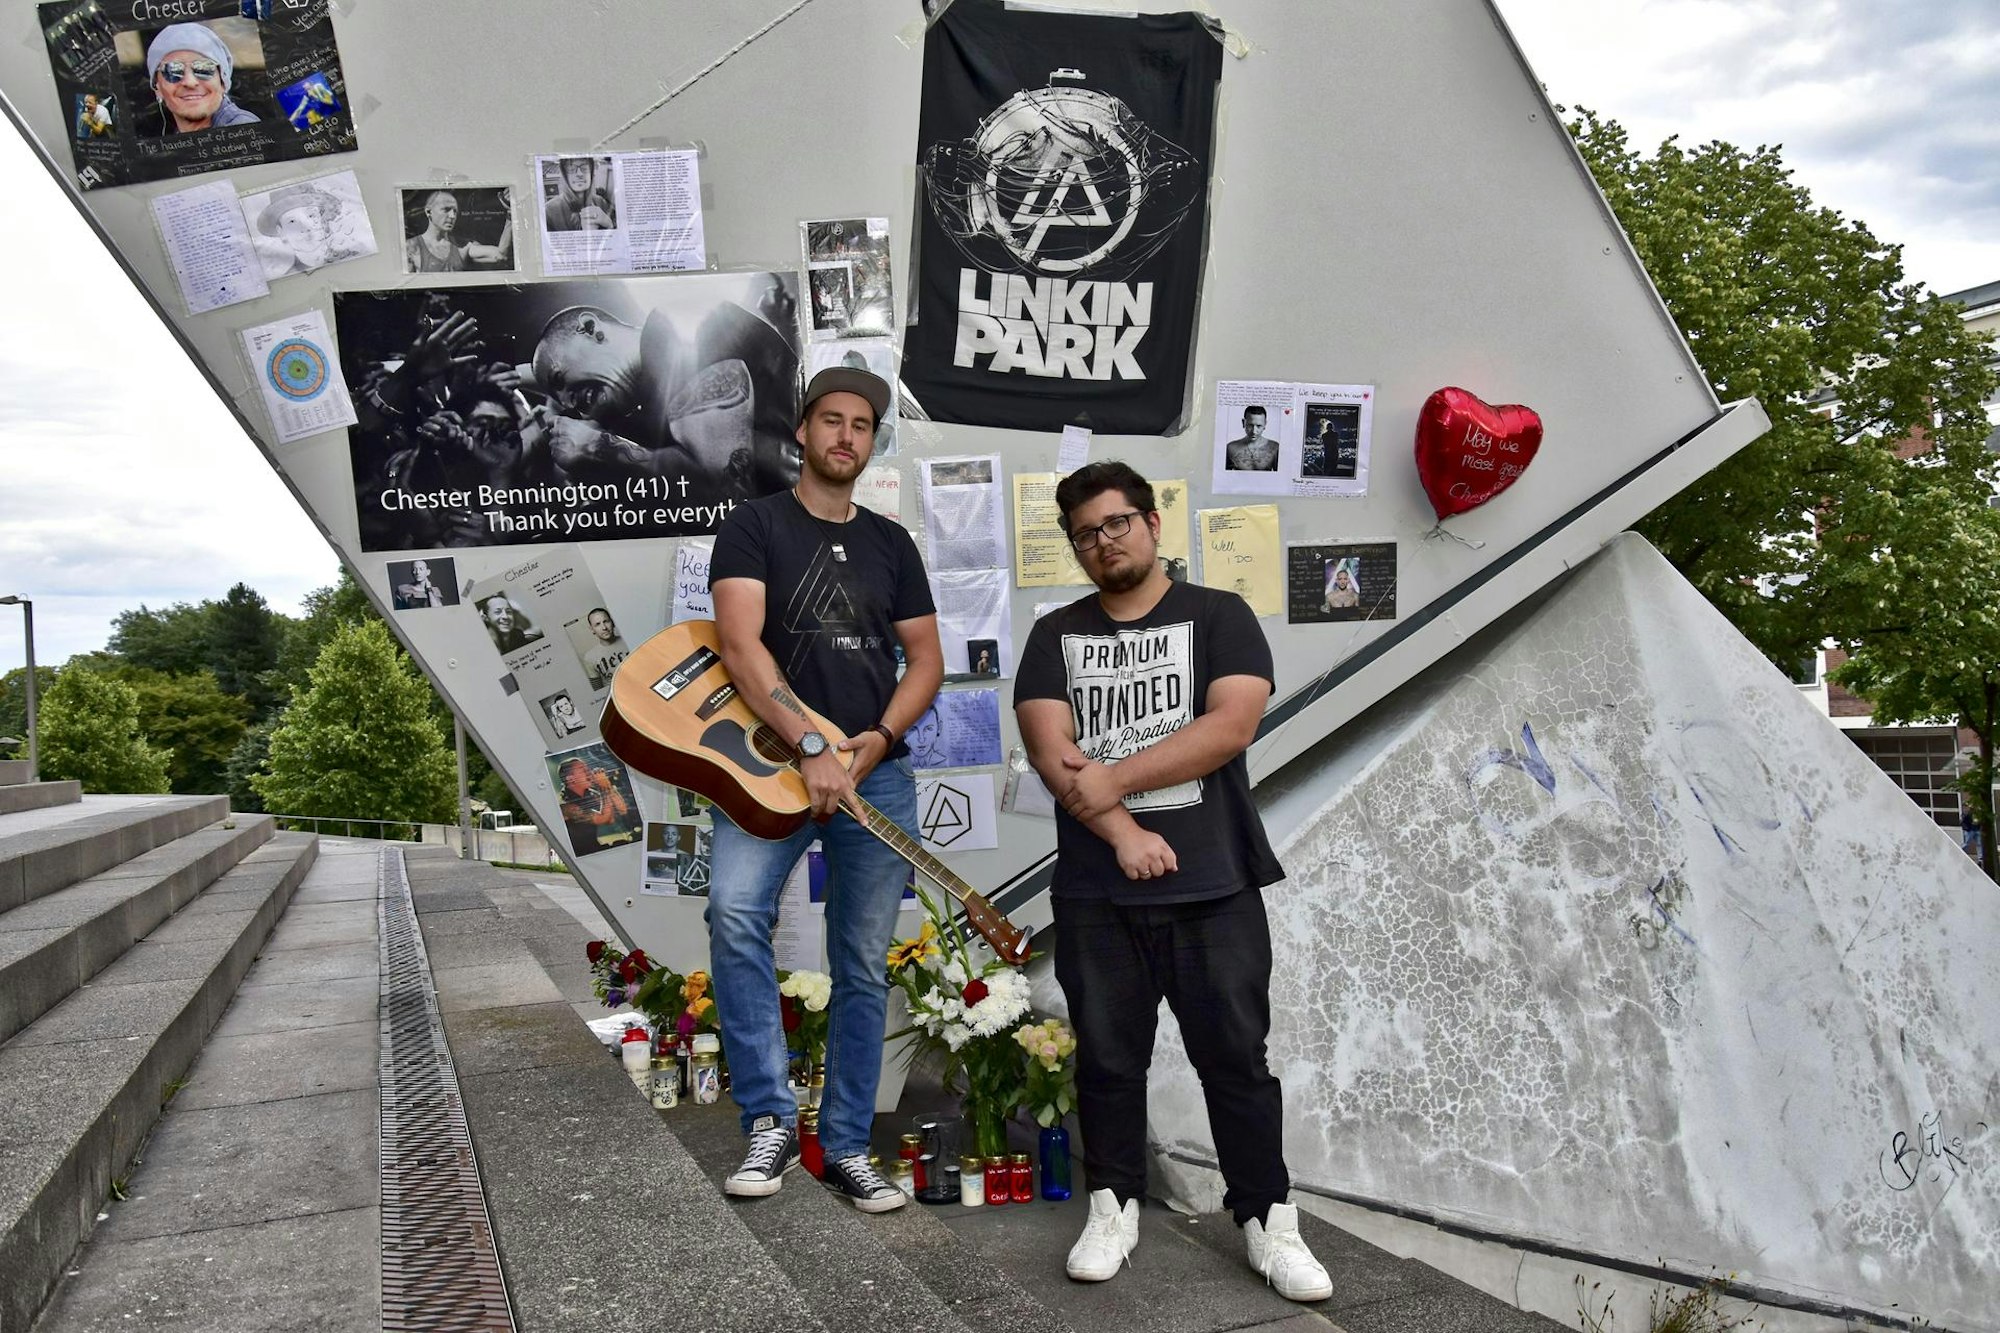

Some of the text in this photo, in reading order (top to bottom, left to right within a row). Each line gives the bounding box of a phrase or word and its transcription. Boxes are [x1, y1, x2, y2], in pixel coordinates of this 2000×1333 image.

[131, 0, 209, 21] Chester
[958, 267, 1154, 333] LINKIN
[953, 311, 1150, 381] PARK
[1462, 423, 1519, 455] May we
[1461, 454, 1496, 471] meet
[380, 488, 472, 511] Chester
[478, 481, 618, 510] Bennington
[625, 475, 670, 502] (41)
[483, 498, 737, 535] Thank you for everyt
[504, 561, 539, 582] Chester
[680, 549, 711, 577] Kee
[1083, 634, 1168, 669] PREMUM
[1119, 711, 1187, 749] Product
